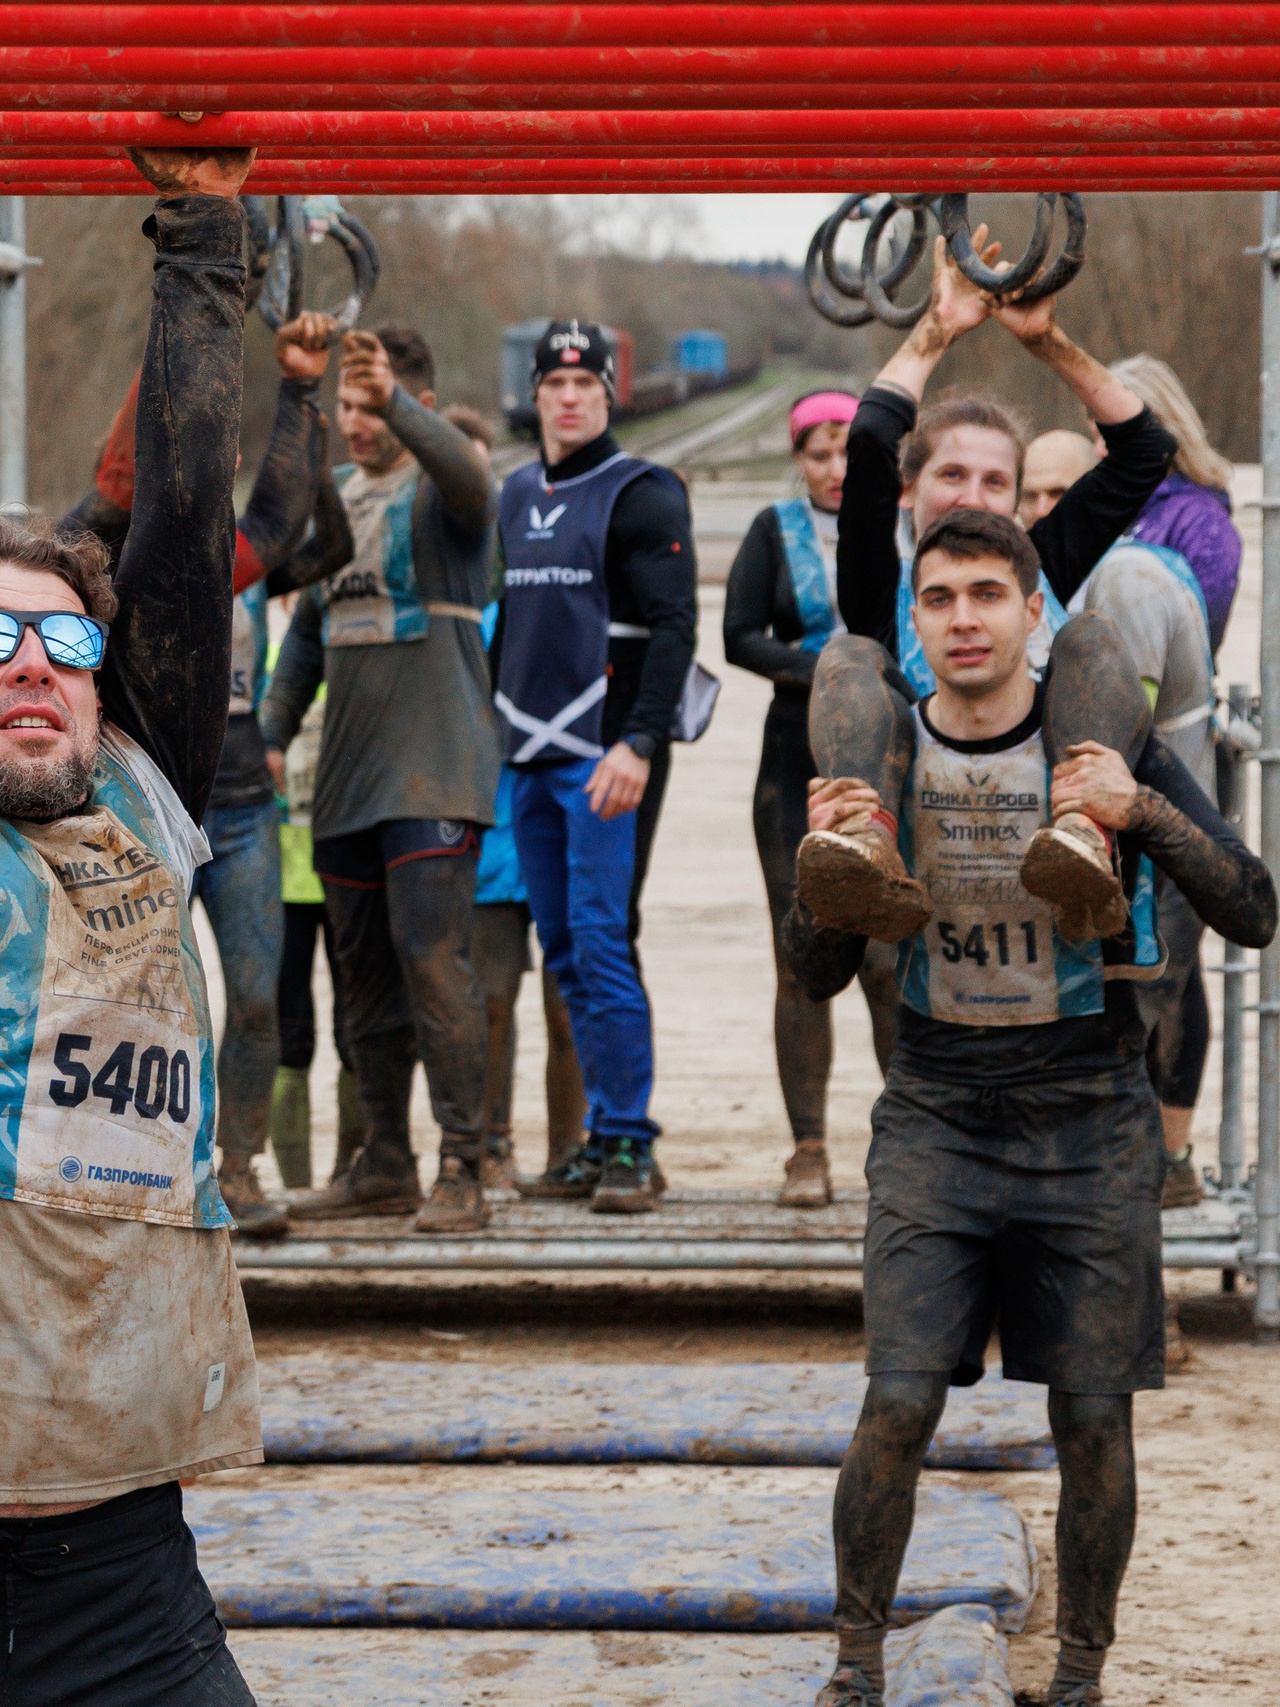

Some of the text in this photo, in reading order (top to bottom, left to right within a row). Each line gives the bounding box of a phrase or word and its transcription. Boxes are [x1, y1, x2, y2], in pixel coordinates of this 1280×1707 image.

[921, 790, 1039, 806] ГОНКА ГЕРОЕВ
[937, 819, 1022, 841] Sminex
[51, 861, 110, 883] НКА
[73, 887, 179, 932] mine
[937, 921, 1038, 967] 5411
[81, 951, 108, 968] FINE
[49, 1033, 191, 1124] 5400
[87, 1165, 173, 1190] ГАЗПРОМБАНК
